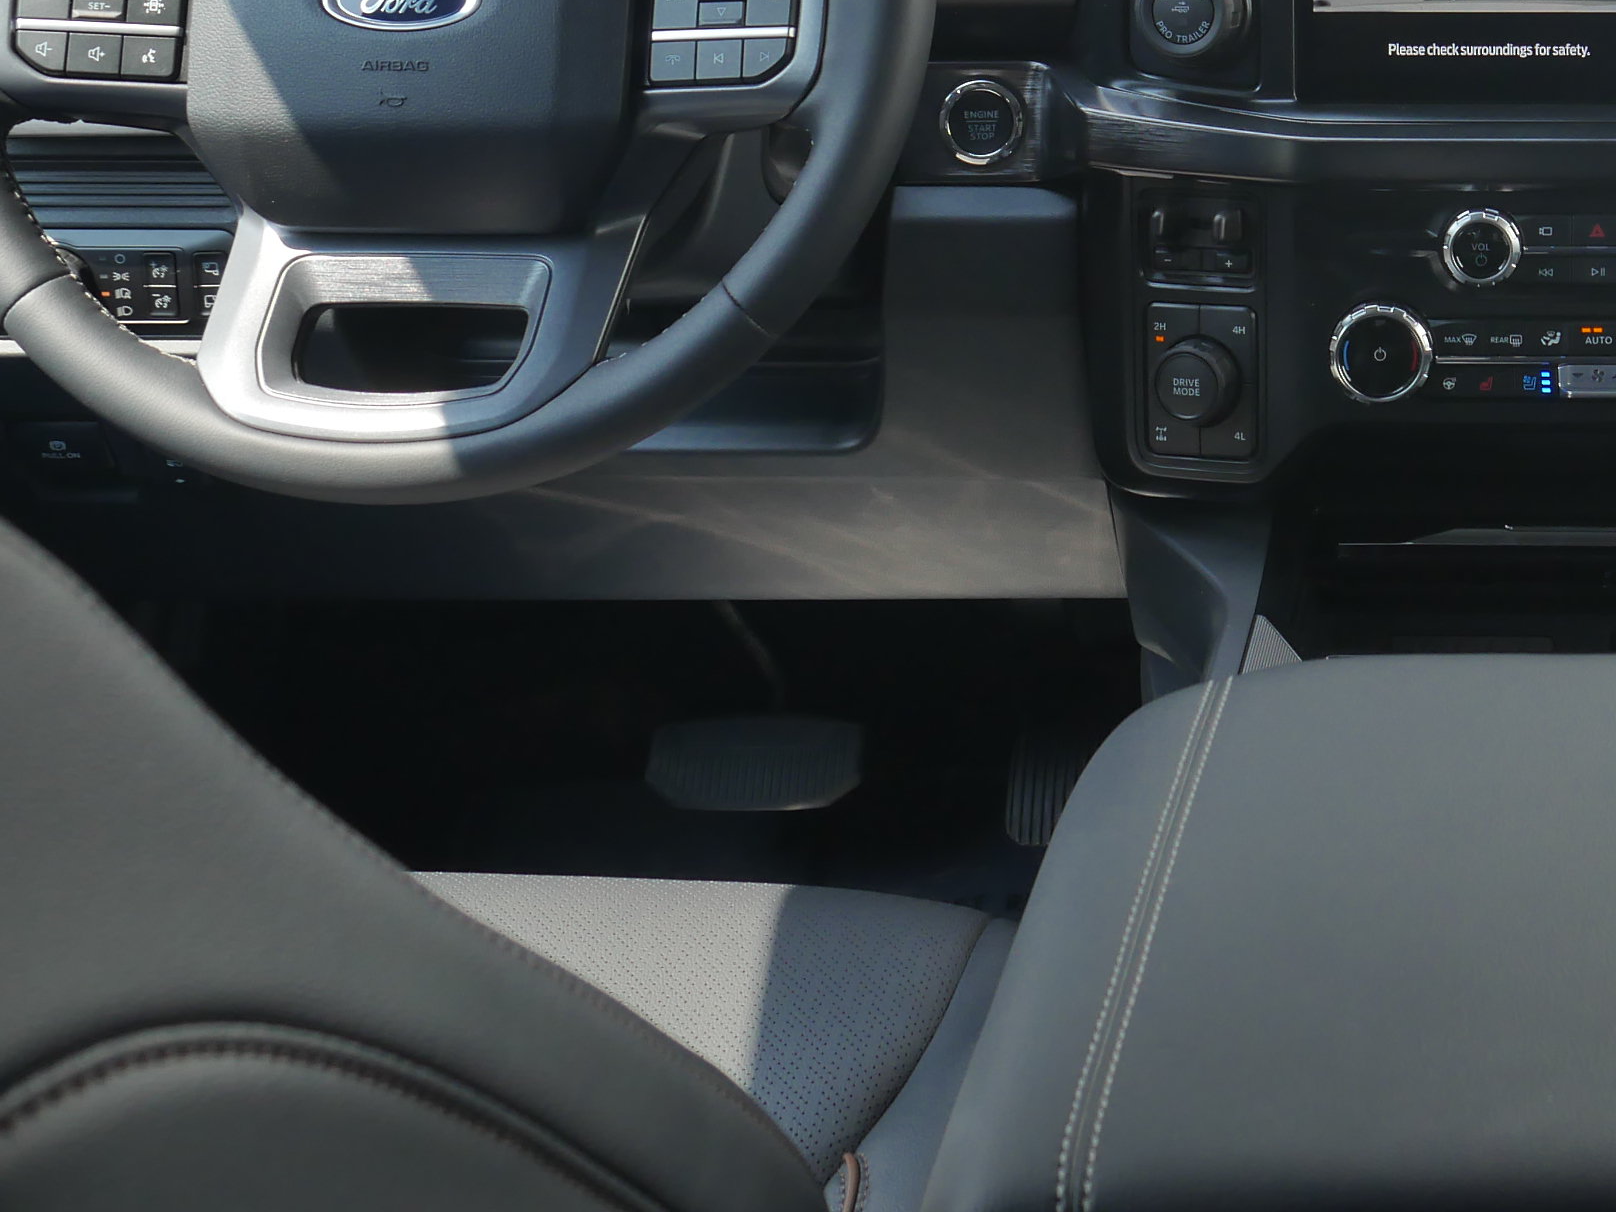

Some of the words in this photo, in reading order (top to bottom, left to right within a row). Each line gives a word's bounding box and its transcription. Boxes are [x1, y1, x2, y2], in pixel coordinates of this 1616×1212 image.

[1155, 20, 1173, 39] PRO
[1176, 20, 1211, 43] TRAILER
[1388, 43, 1426, 56] Please
[1427, 42, 1459, 56] check
[1460, 42, 1533, 58] surroundings
[1534, 42, 1552, 56] for
[1552, 42, 1591, 58] safety.
[361, 60, 430, 72] AIRBAG
[964, 110, 1000, 119] ENGINE
[967, 124, 997, 133] START
[970, 132, 995, 140] STOP
[1471, 243, 1491, 251] VOL
[1153, 322, 1167, 331] 2H
[1232, 325, 1246, 335] 4H
[1585, 336, 1613, 345] AUTO
[1172, 378, 1200, 388] DRIVE
[1172, 387, 1200, 397] MODE
[1234, 432, 1246, 441] 4L
